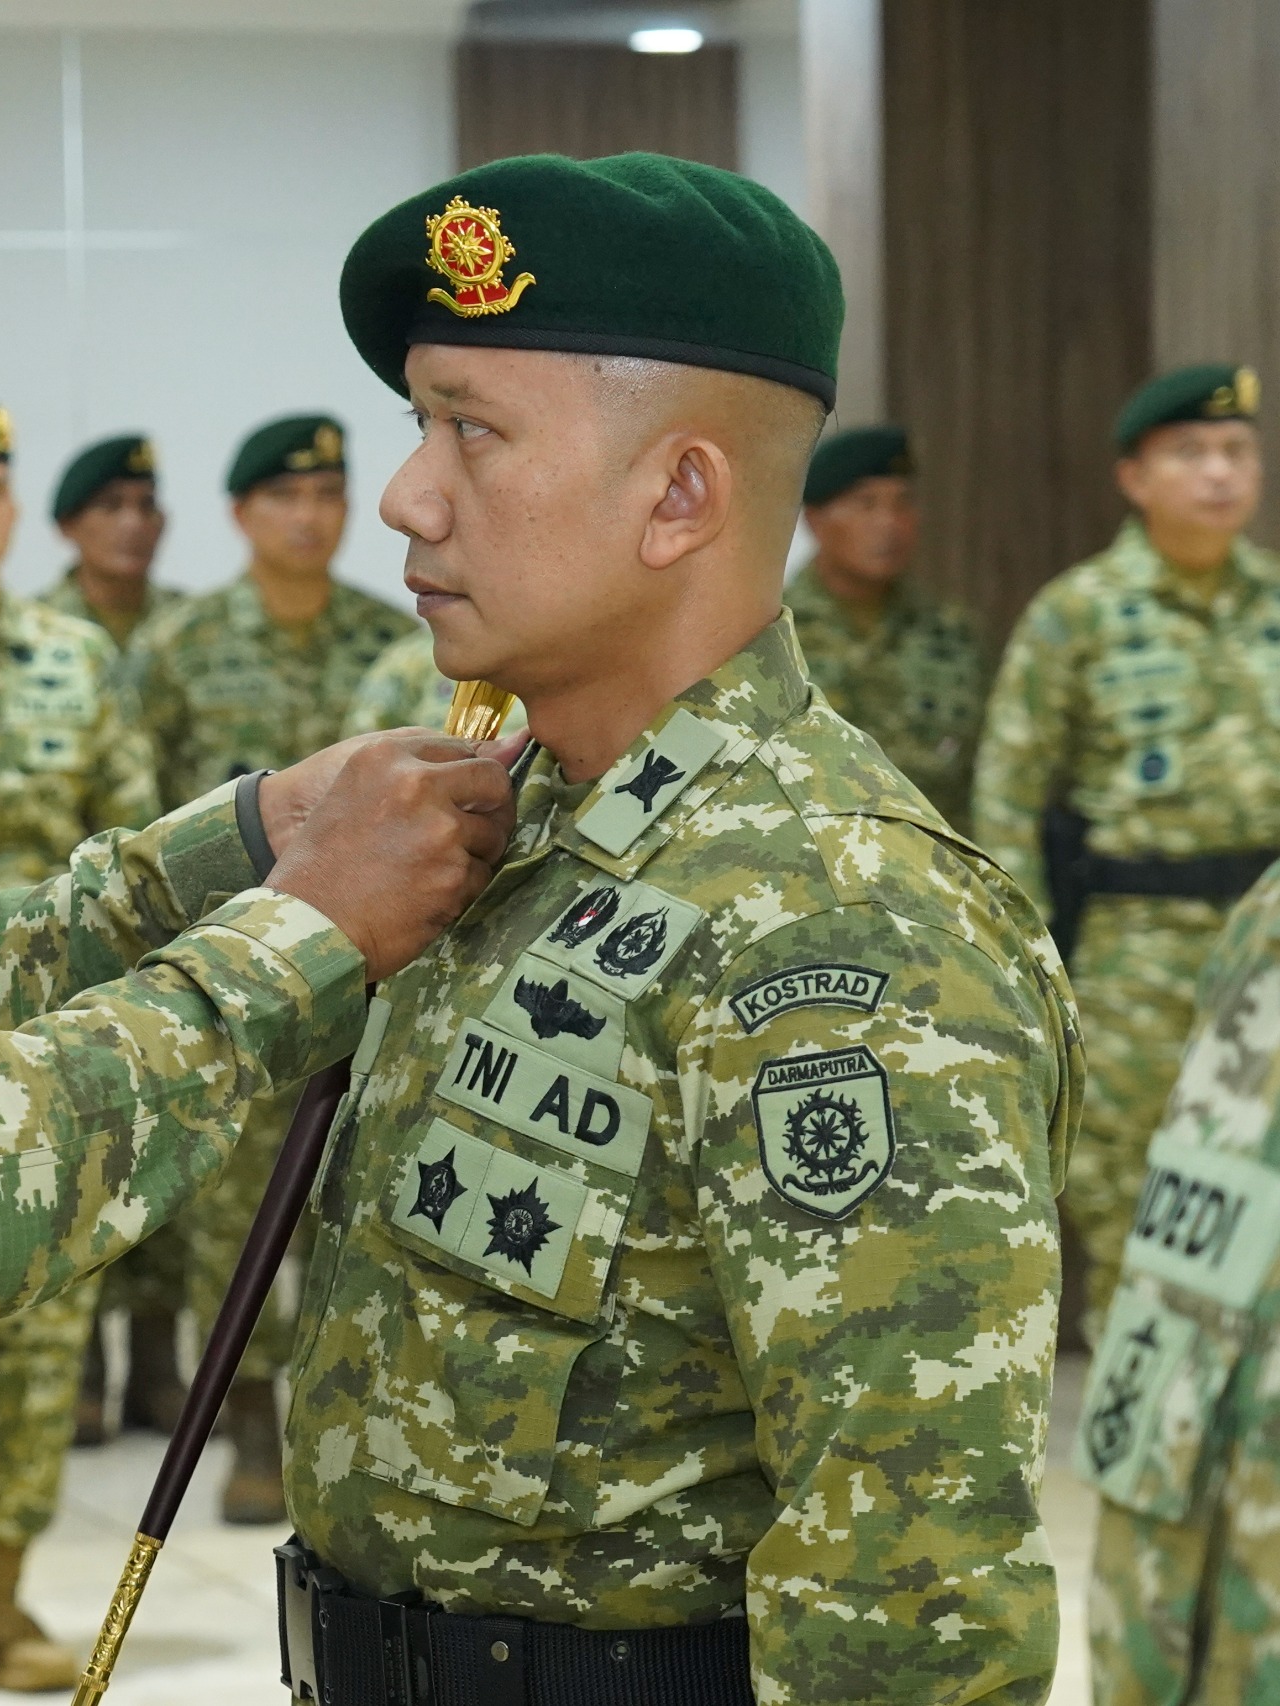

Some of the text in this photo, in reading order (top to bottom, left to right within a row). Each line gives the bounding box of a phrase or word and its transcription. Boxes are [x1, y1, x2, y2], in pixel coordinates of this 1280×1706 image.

[743, 973, 870, 1019] KOSTRAD
[451, 1033, 621, 1147] TNI AD
[767, 1055, 869, 1086] DARMAPUTRA
